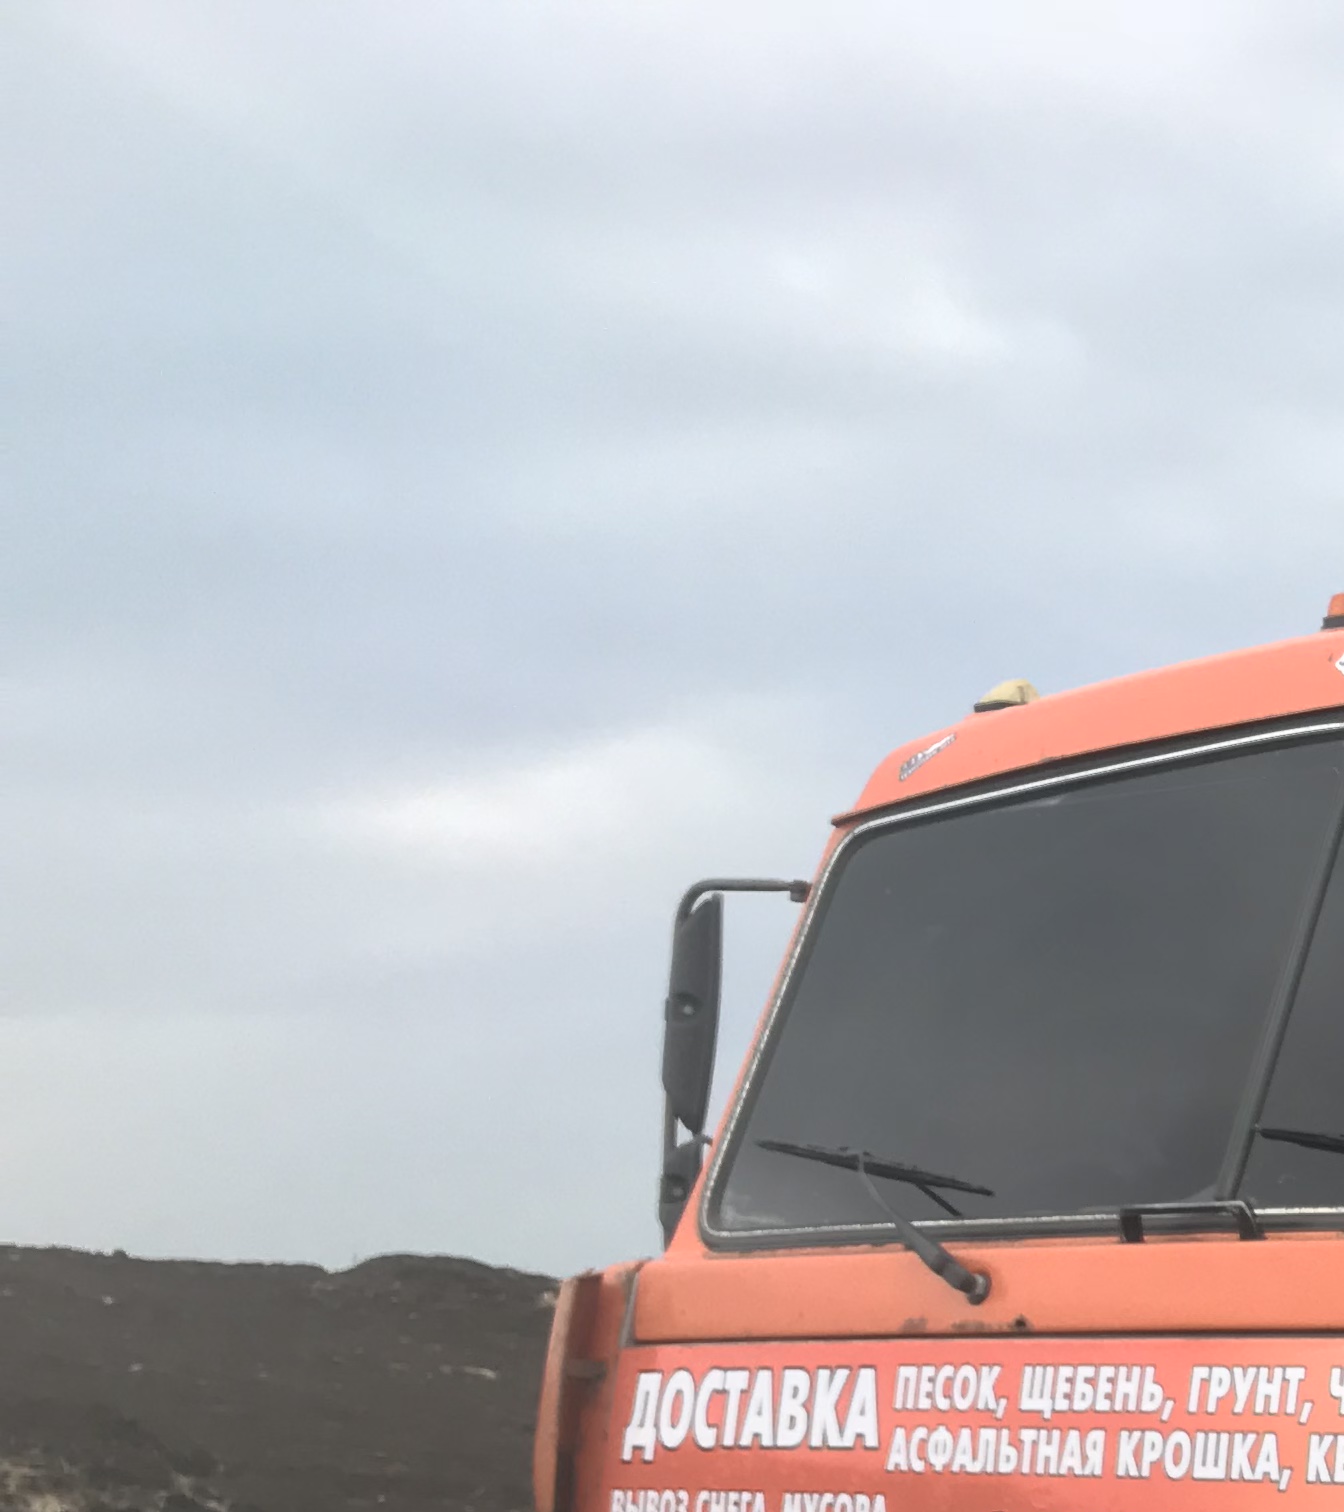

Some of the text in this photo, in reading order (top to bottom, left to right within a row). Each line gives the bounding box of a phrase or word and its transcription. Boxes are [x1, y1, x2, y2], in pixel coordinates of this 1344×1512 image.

[621, 1365, 879, 1462] ДОСТАВКА
[893, 1364, 1008, 1418] ПЕСОК,
[1018, 1365, 1174, 1421] ЩЕБЕНЬ,
[1188, 1365, 1312, 1425] ГРУНТ,
[885, 1426, 1105, 1477] АСФАЛЬТНАЯ
[1116, 1429, 1292, 1491] КРОШКА,
